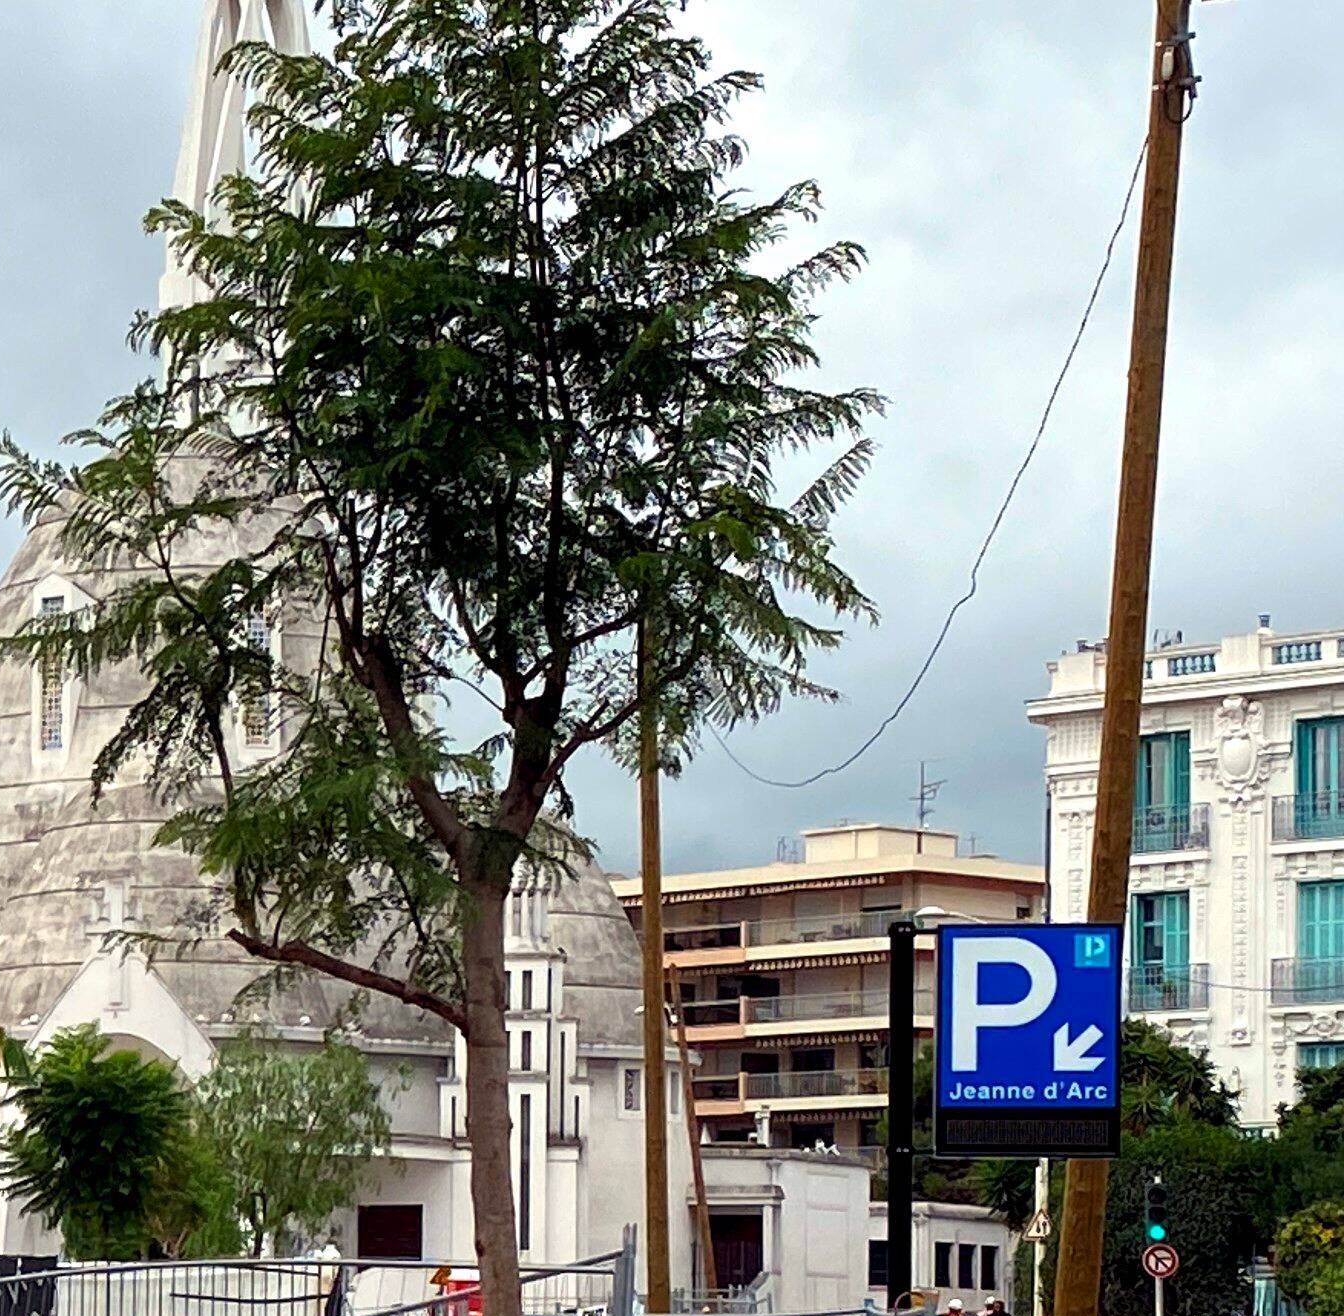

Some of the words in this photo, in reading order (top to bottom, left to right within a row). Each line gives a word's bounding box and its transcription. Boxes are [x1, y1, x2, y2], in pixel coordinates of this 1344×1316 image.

[951, 937, 1058, 1072] P
[949, 1082, 1035, 1101] Jeanne
[1043, 1082, 1108, 1101] d'Arc
